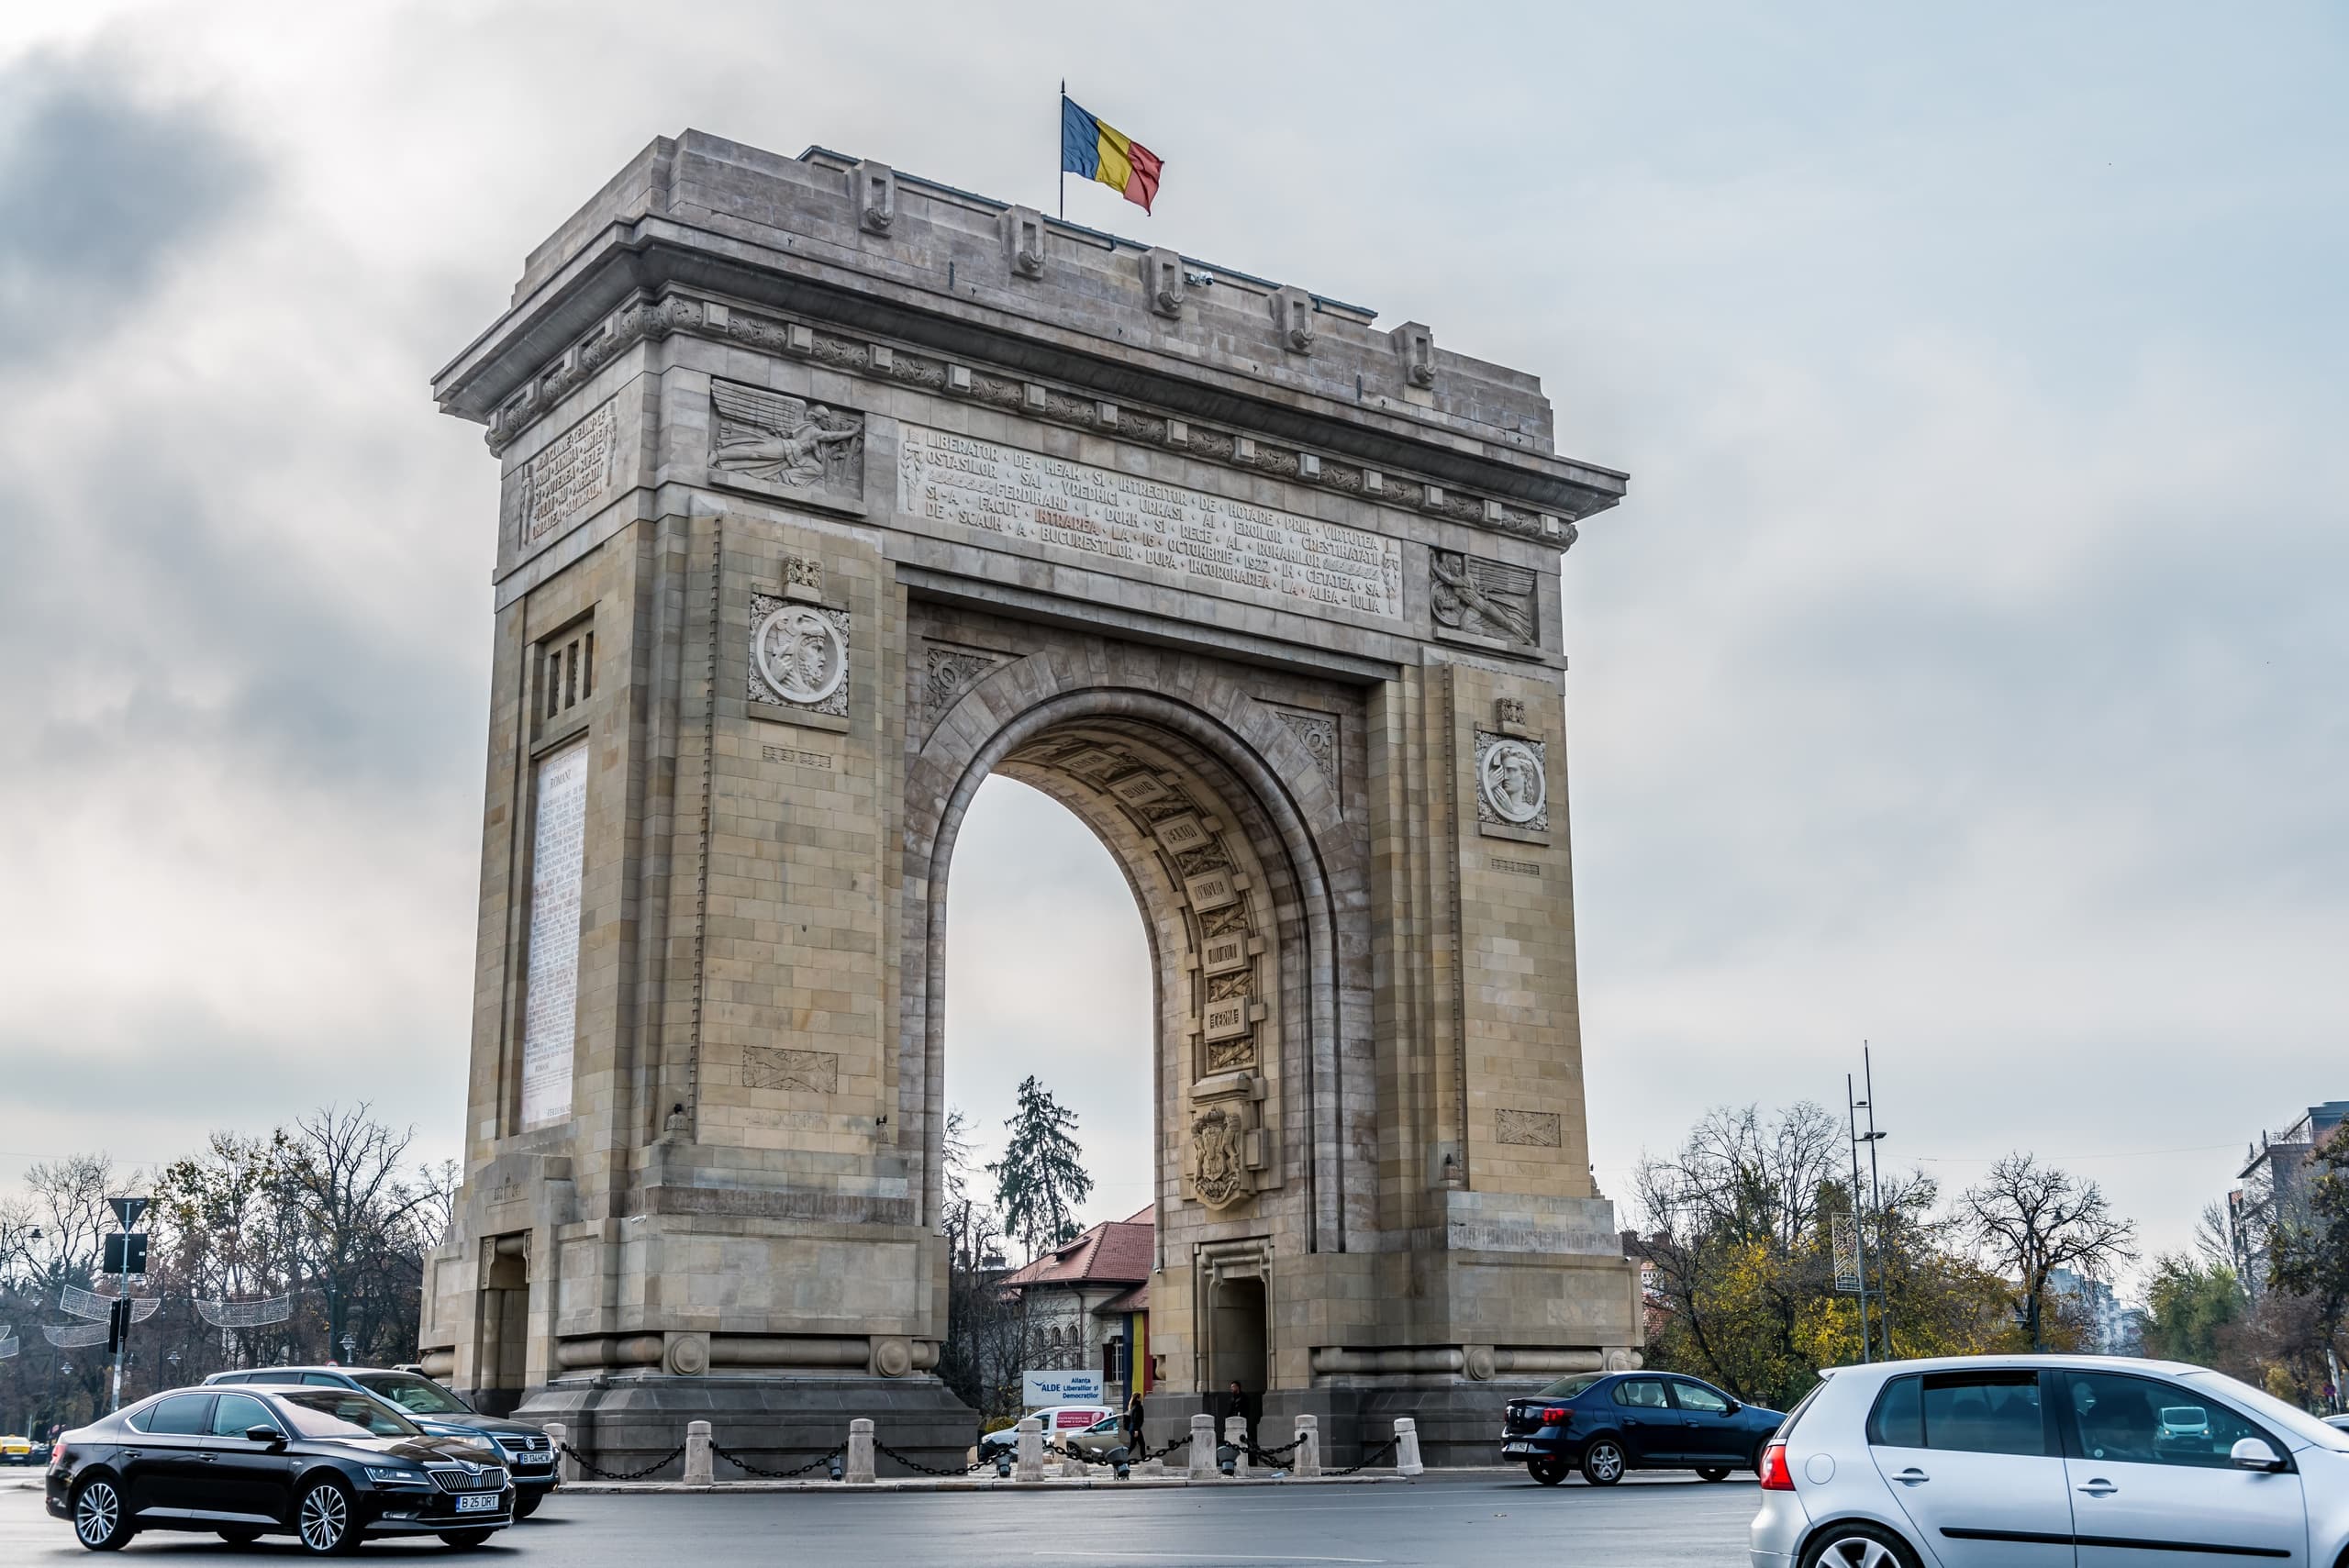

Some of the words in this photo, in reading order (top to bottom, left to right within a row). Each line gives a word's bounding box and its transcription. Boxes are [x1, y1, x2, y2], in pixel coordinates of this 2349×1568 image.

[926, 431, 999, 462] LIBERATOR
[1013, 451, 1031, 470] DE
[1199, 495, 1217, 513] DE
[1228, 502, 1275, 528] HOTARE
[1285, 515, 1312, 536] PRIN
[1322, 524, 1379, 551] VIRTUTEA
[995, 482, 1069, 512] FERDINAND
[1226, 535, 1243, 552] AL
[1061, 479, 1119, 507] VREDNICI
[1234, 520, 1283, 544] EROILOR
[925, 500, 945, 520] DE
[1014, 520, 1028, 538] A
[1145, 549, 1178, 570] DUPA
[1188, 558, 1273, 590] INCORONAREA
[1281, 579, 1298, 596] LA
[1034, 507, 1102, 536] INTRAREA
[1111, 525, 1130, 543] LA
[1142, 531, 1154, 548] 16
[1167, 538, 1233, 565] OCTOMBRIE
[1244, 555, 1271, 573] 1922
[1306, 569, 1356, 593] CETATEA
[1364, 582, 1381, 598] SA
[462, 1497, 468, 1508] B
[470, 1496, 480, 1507] 25
[481, 1496, 497, 1507] DRT
